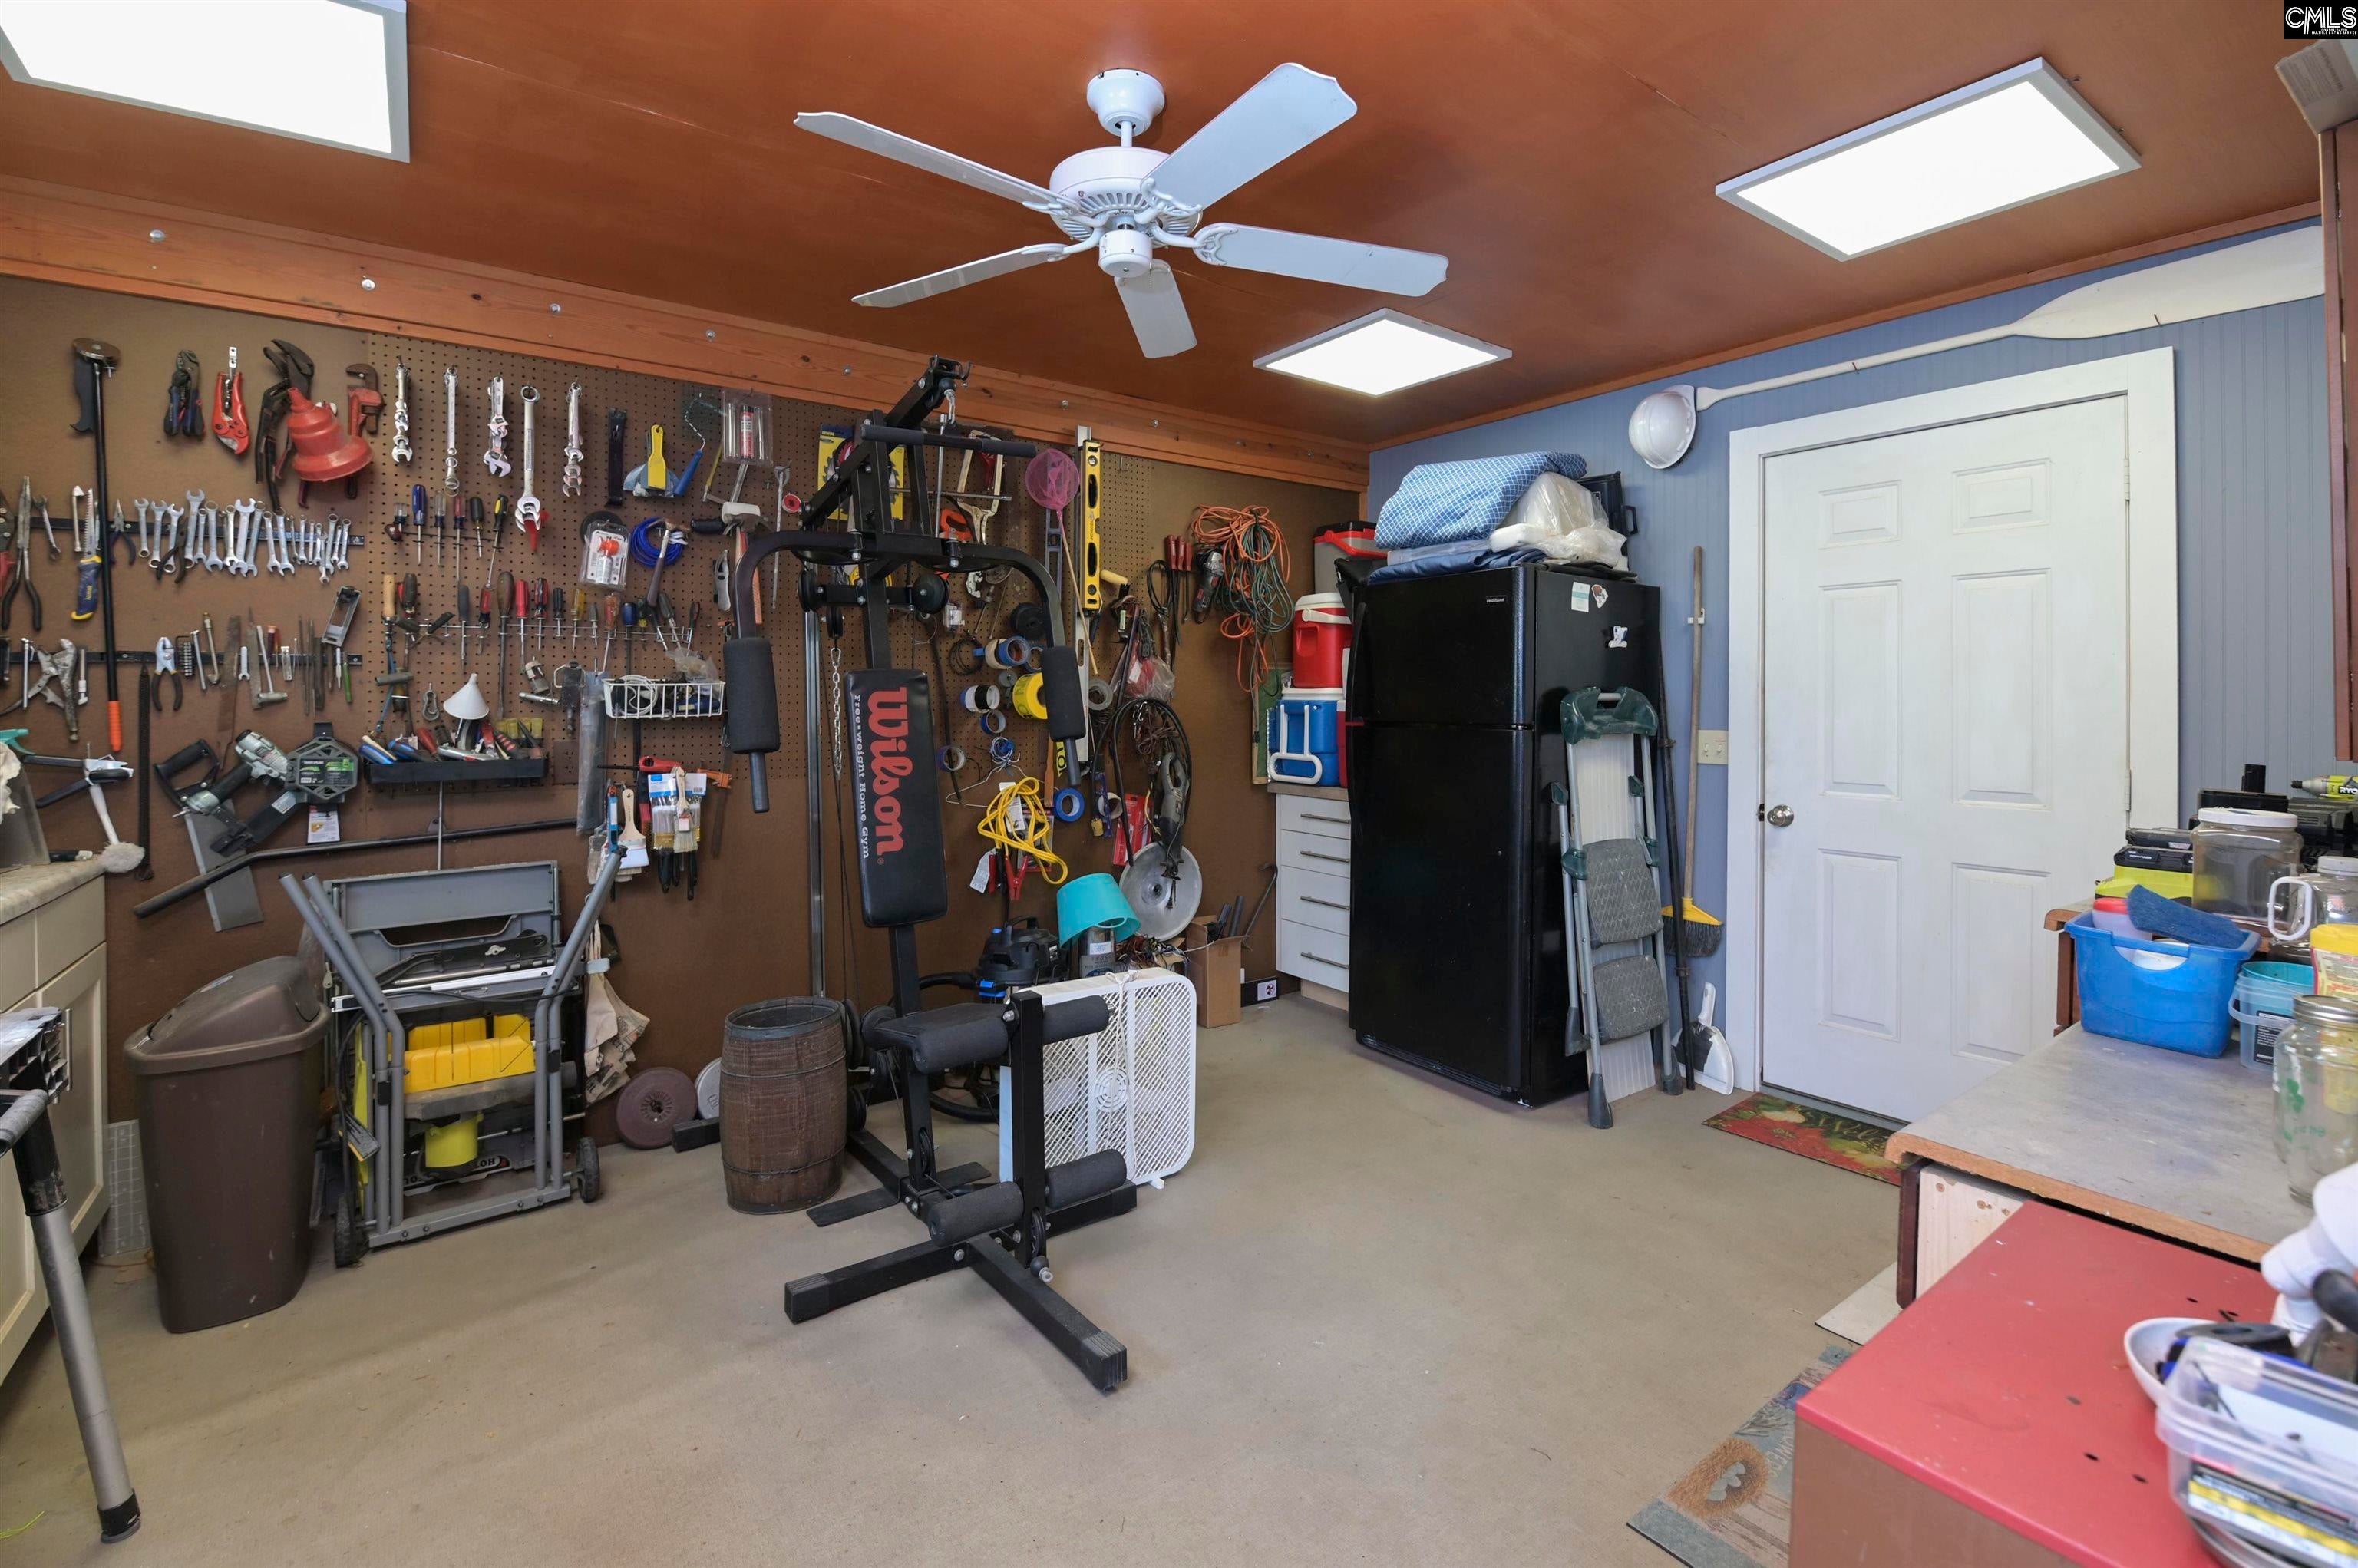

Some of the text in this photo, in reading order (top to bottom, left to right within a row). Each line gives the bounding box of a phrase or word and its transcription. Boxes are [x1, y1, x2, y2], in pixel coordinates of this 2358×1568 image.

[867, 686, 913, 856] Wilson
[859, 782, 867, 822] Home
[860, 826, 870, 859] Gym
